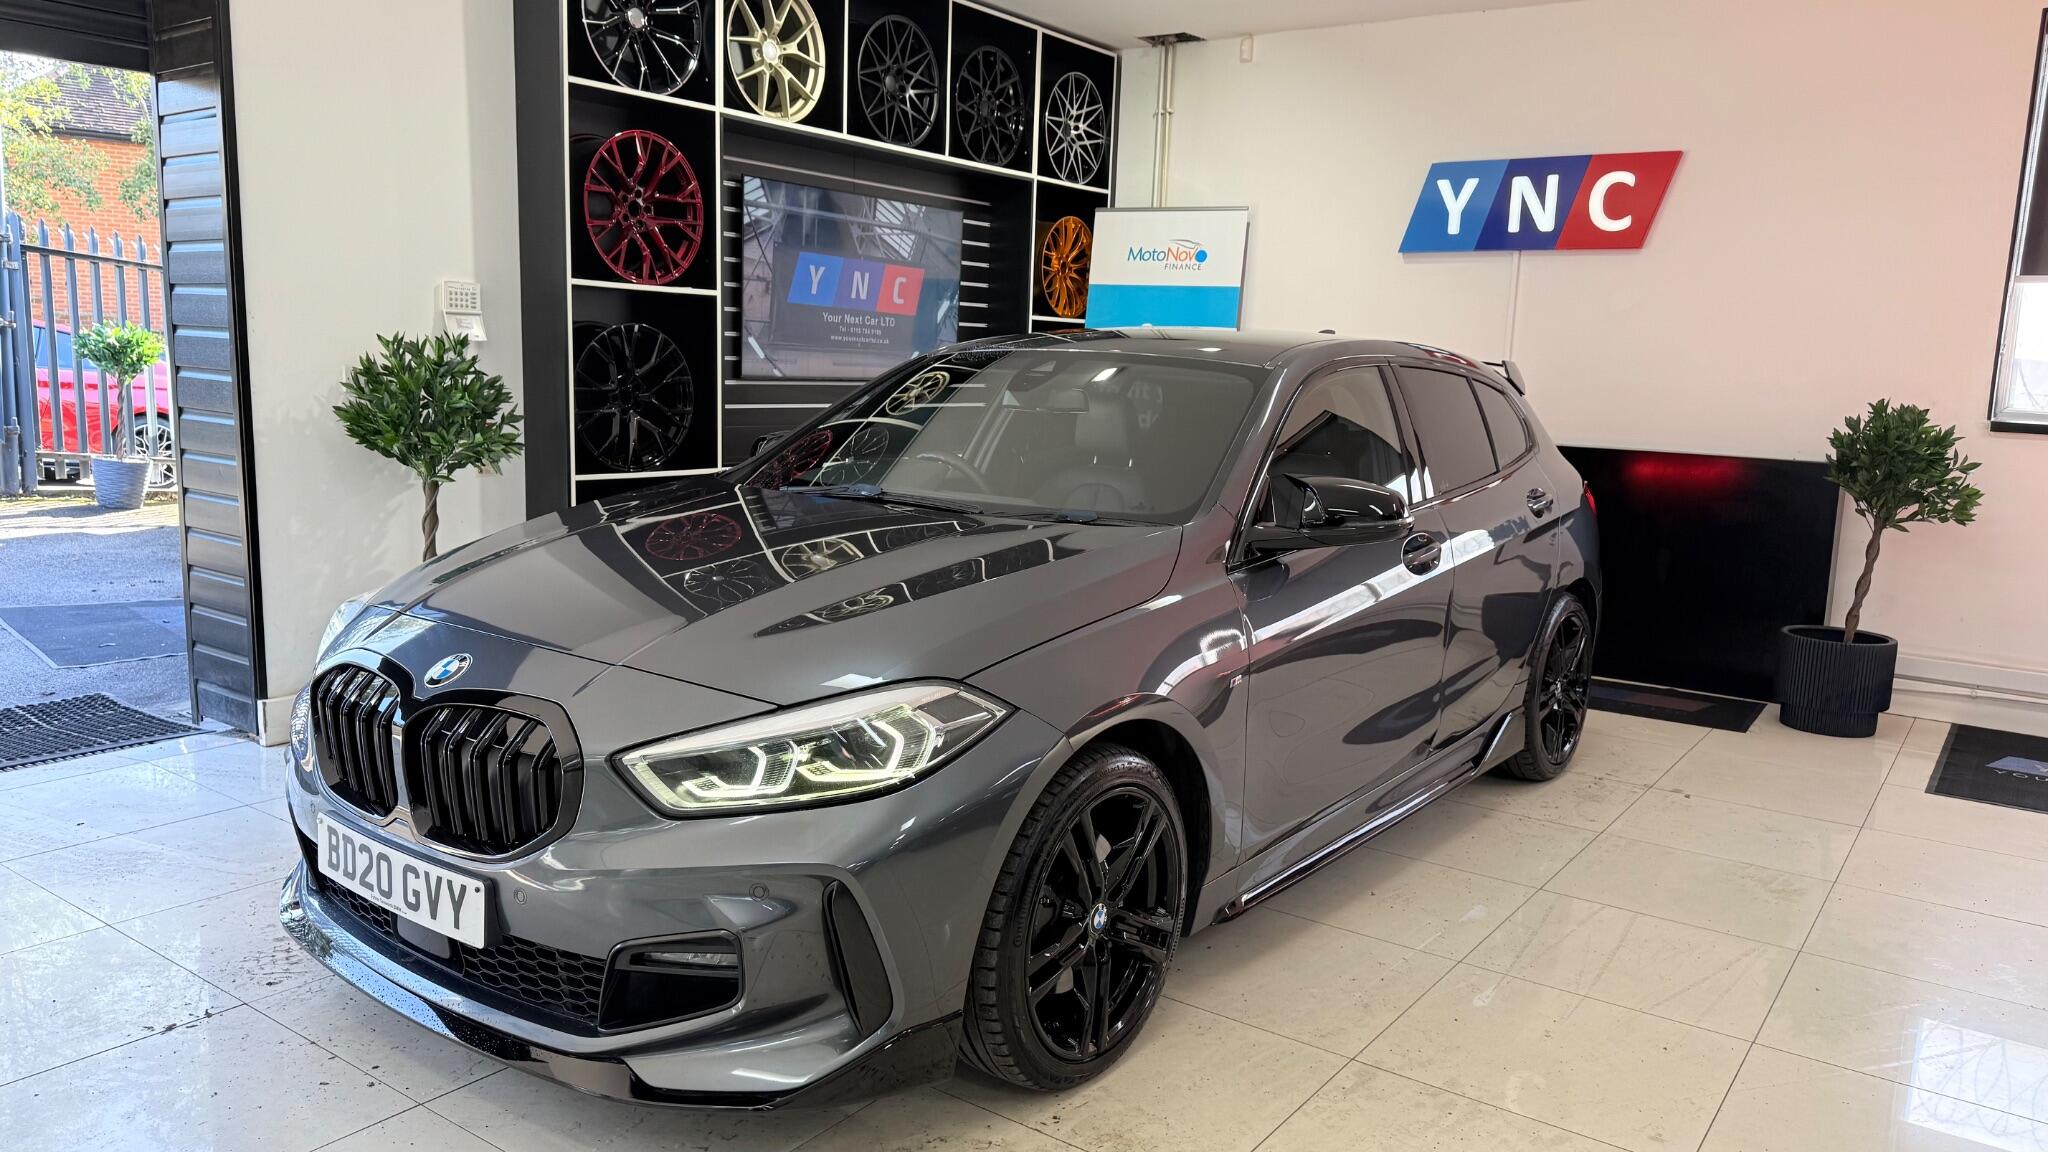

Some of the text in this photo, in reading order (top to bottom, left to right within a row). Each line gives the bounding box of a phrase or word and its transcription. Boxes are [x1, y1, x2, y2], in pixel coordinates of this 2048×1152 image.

[1436, 170, 1636, 235] YNC
[809, 264, 907, 305] YNC
[1164, 263, 1202, 271] FINANCE
[822, 312, 896, 328] Your Next Car LTD
[326, 824, 467, 930] BD20 GVY
